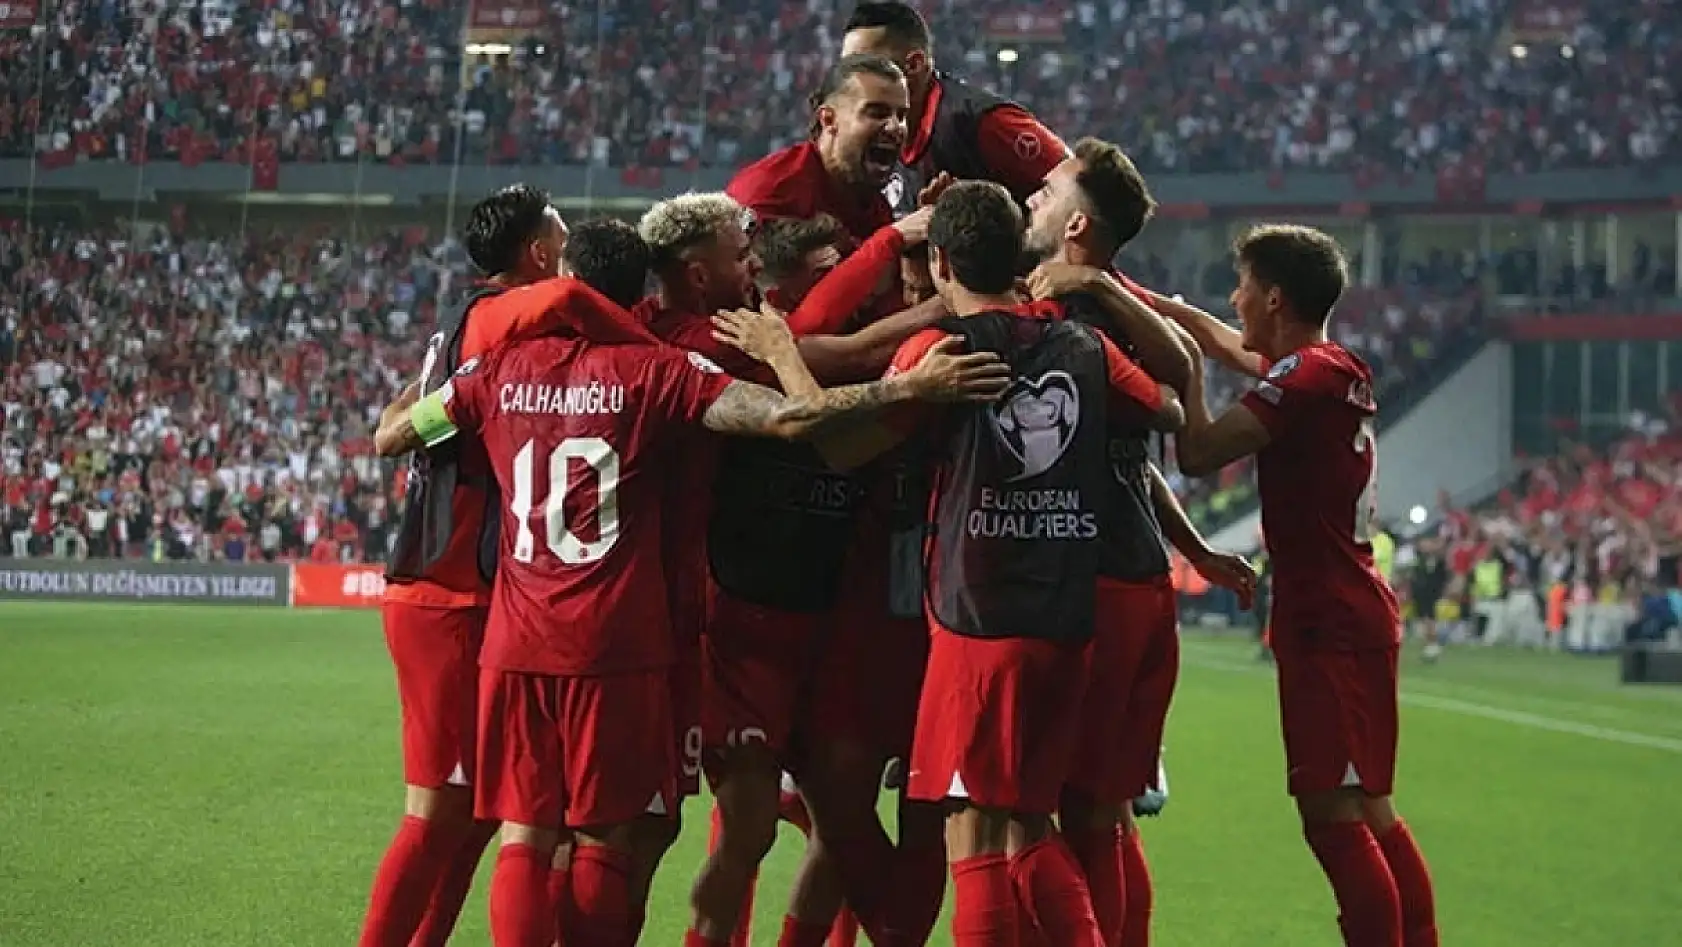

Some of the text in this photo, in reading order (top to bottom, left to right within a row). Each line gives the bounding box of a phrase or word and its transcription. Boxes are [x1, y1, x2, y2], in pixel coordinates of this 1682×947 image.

[500, 381, 625, 415] ÇALHANOĞLU
[510, 436, 620, 564] 10
[967, 509, 1098, 541] QUALIFIERS
